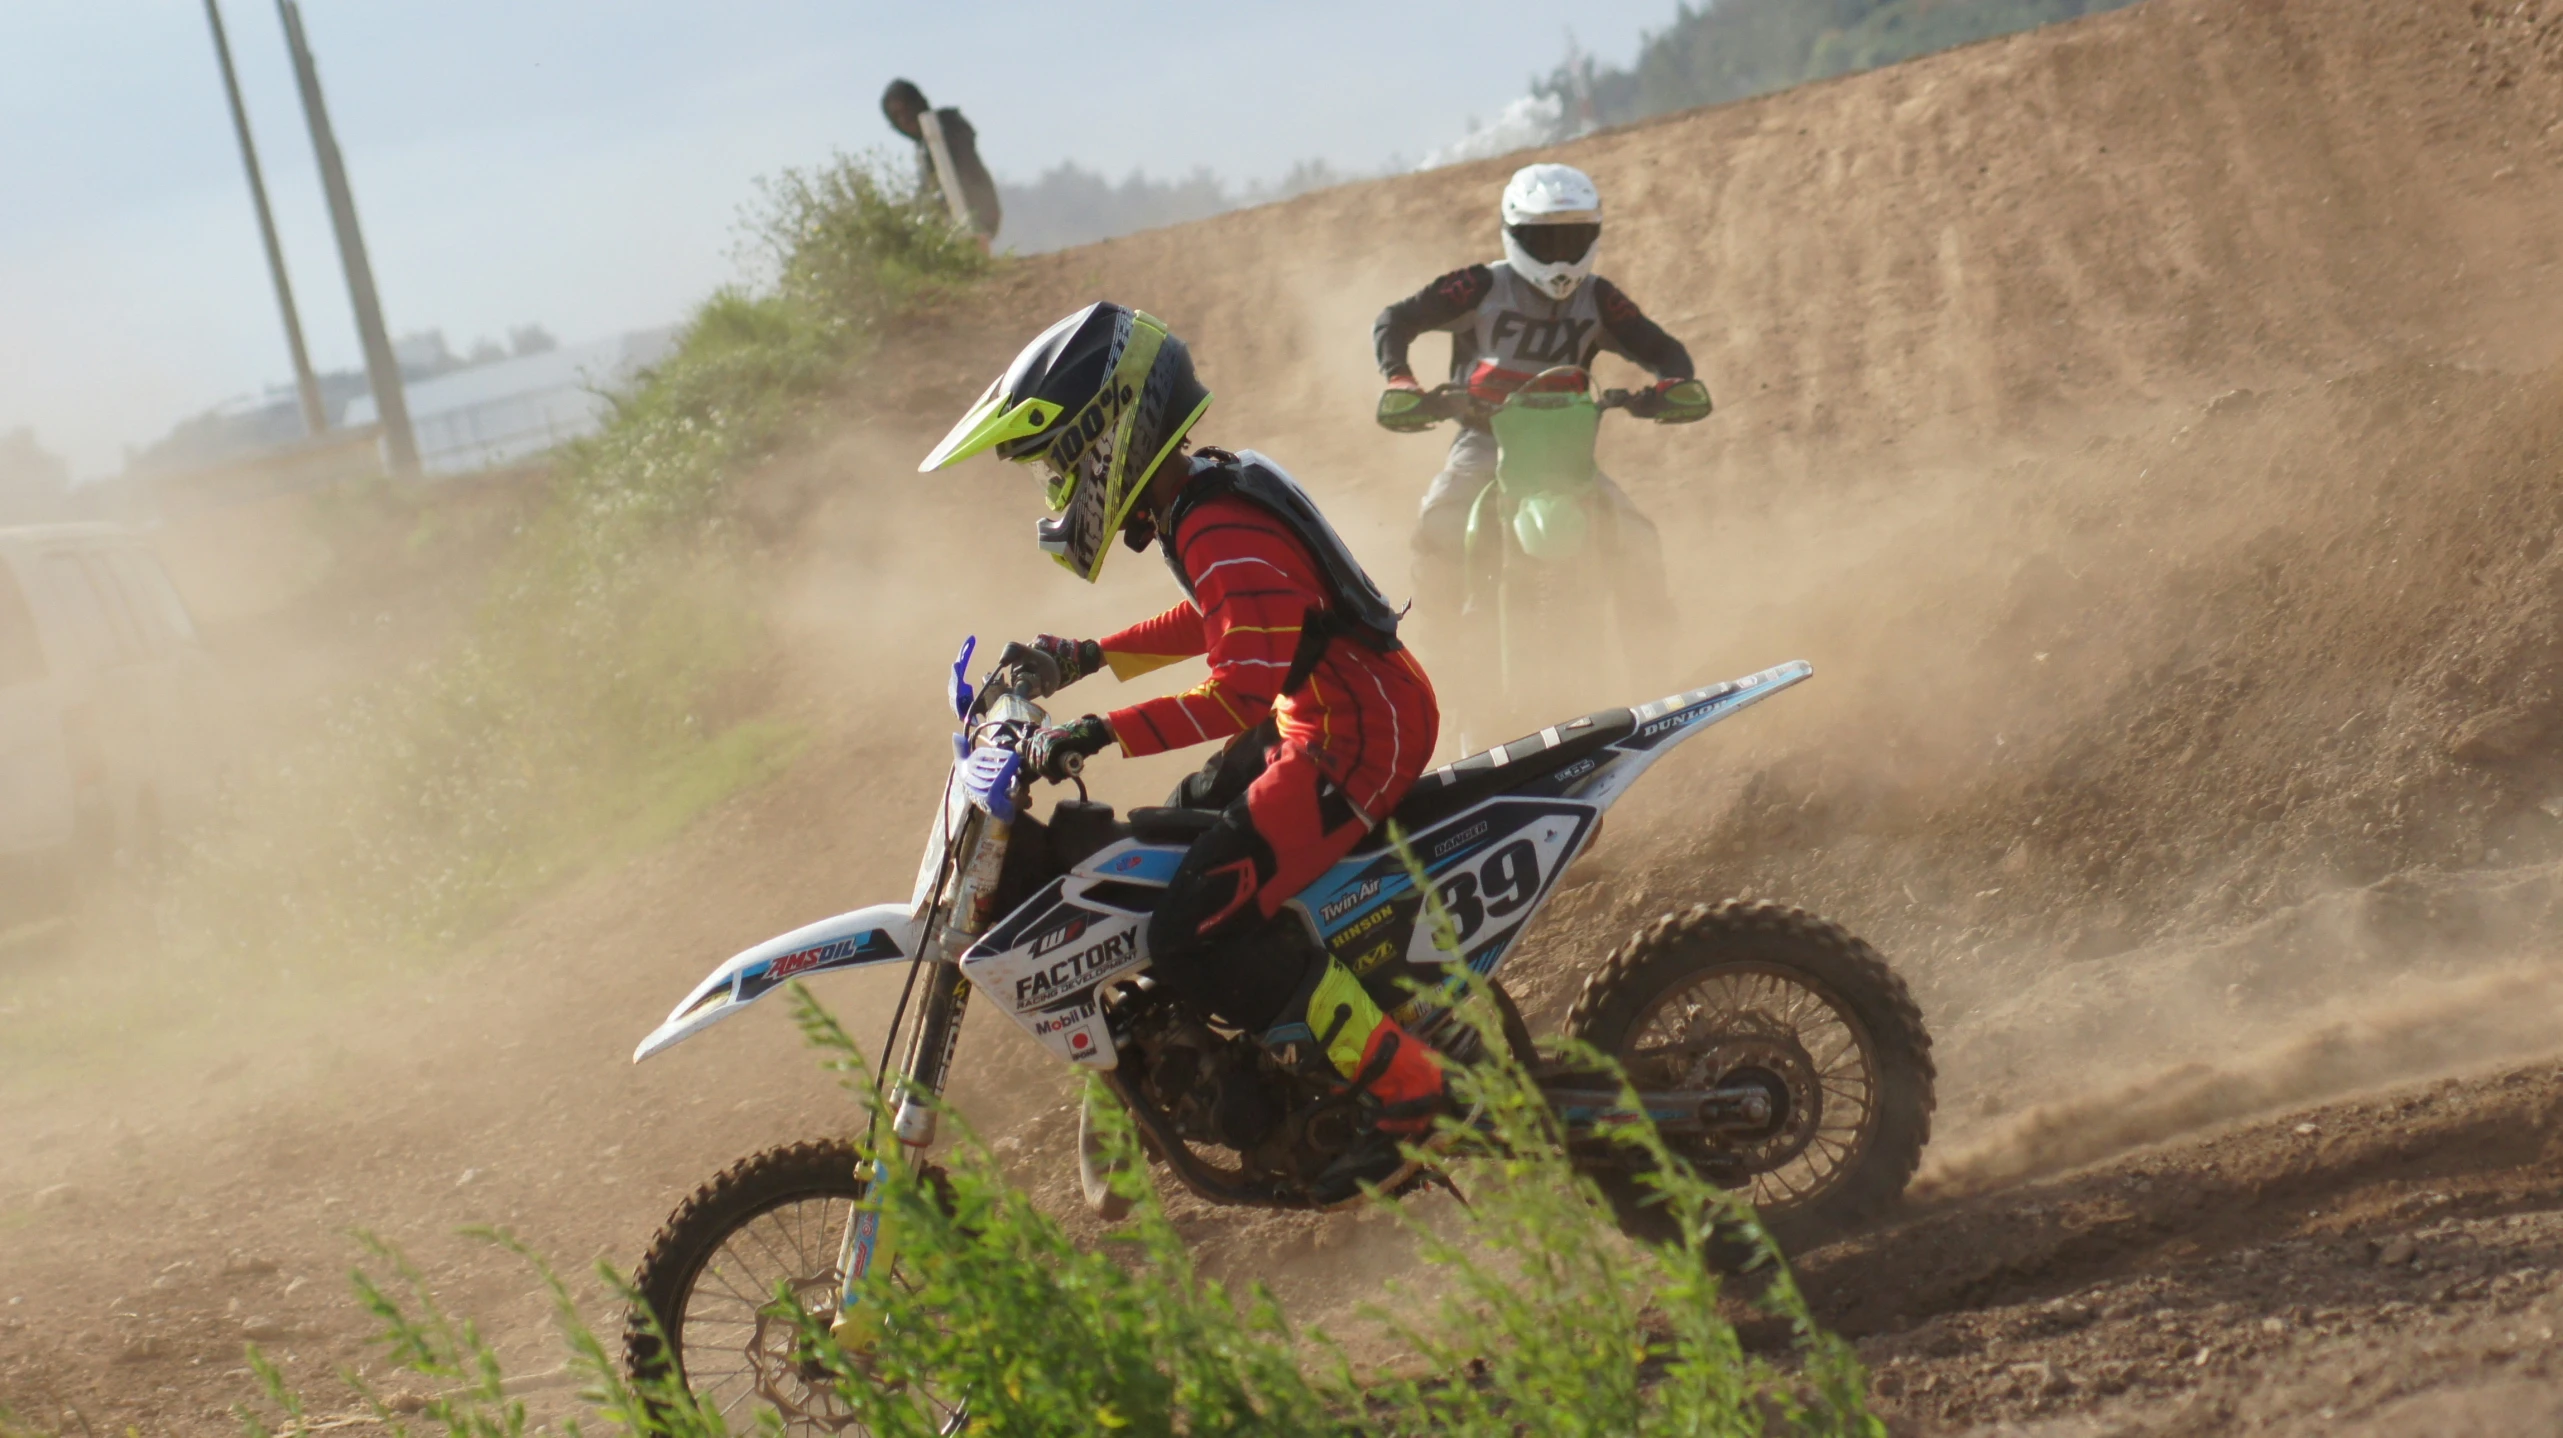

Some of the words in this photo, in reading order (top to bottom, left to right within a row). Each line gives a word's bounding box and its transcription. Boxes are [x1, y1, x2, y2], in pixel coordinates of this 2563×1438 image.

[1493, 310, 1594, 364] FOX
[1050, 374, 1133, 473] 100%
[1643, 699, 1729, 738] DUNLOP
[1319, 893, 1358, 924] Twin
[1359, 877, 1382, 902] Air
[1425, 838, 1541, 952] 39
[762, 938, 857, 979] AMSOIL
[1016, 924, 1138, 1000] FACTORY
[1016, 987, 1059, 1010] RACING
[1061, 951, 1138, 994] DEVELOPMENT
[1035, 1009, 1080, 1036] Mobil
